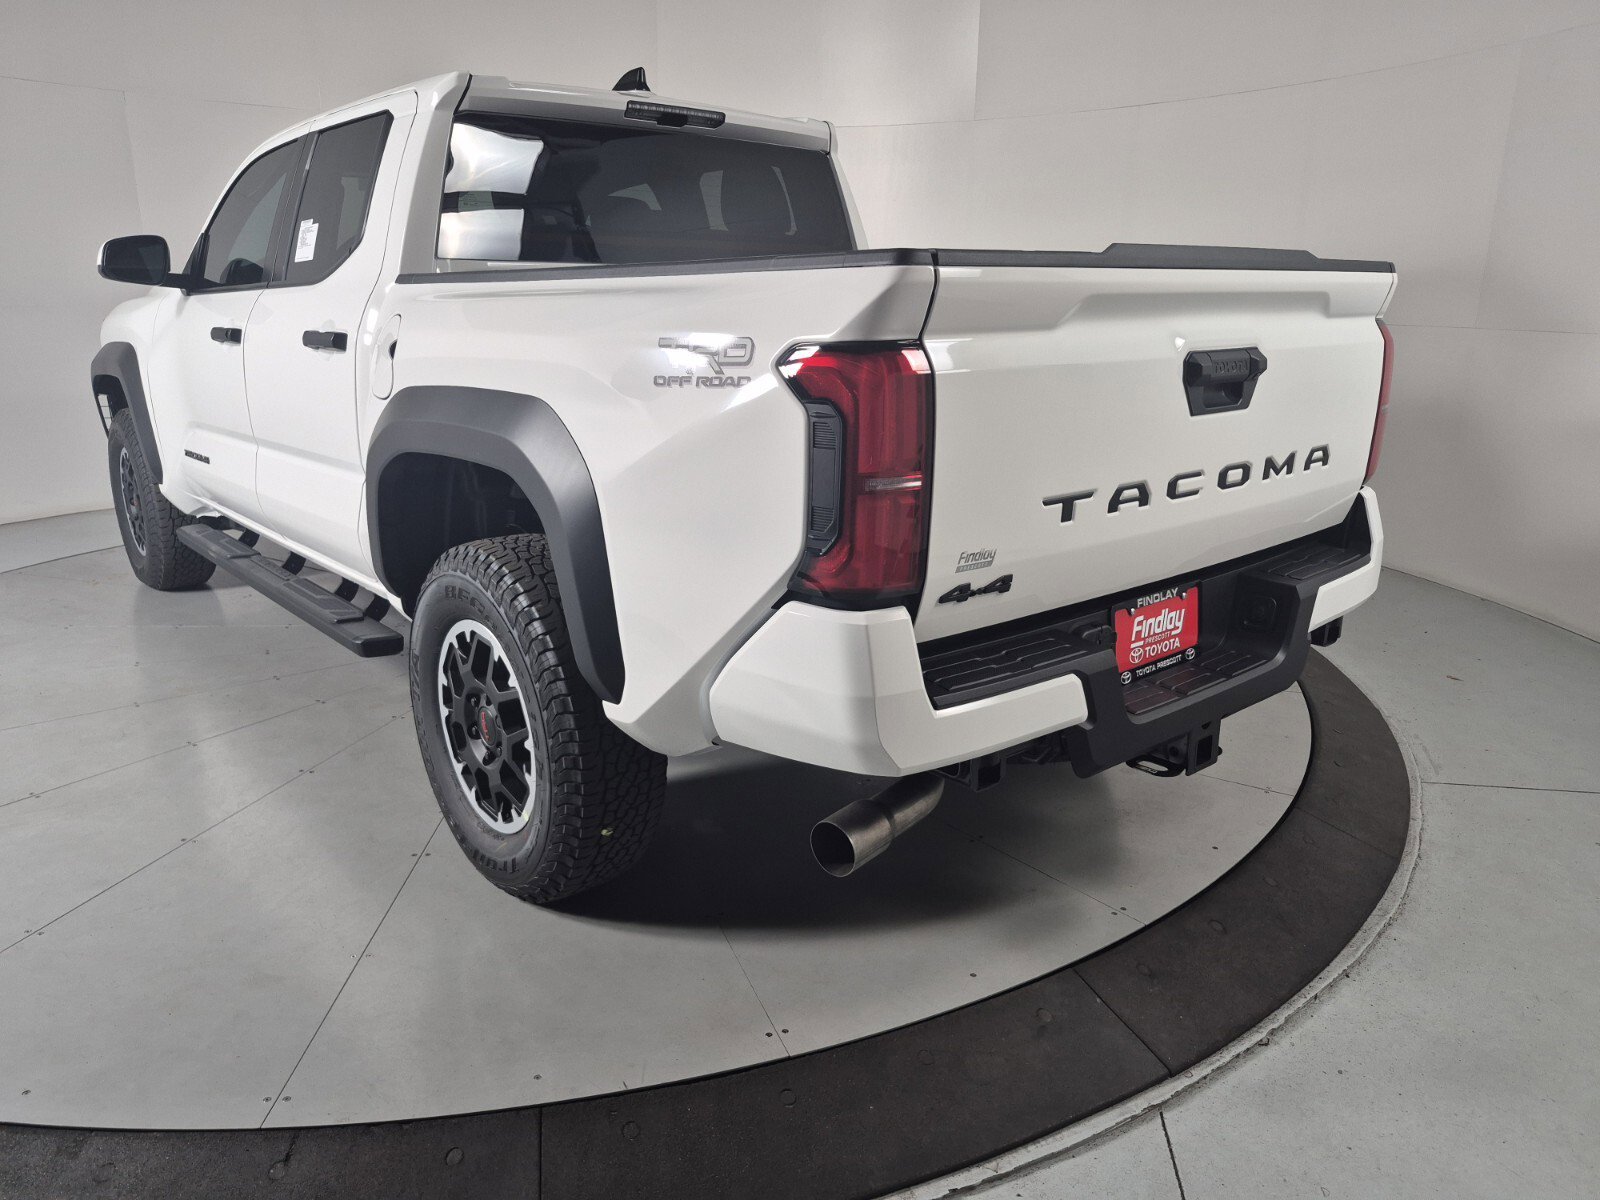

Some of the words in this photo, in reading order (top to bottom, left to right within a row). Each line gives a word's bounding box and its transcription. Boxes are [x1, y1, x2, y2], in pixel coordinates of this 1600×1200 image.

[653, 376, 692, 388] OFF
[695, 376, 752, 389] ROAD
[1042, 443, 1330, 523] TACOMA
[957, 548, 997, 565] Findlay
[1137, 587, 1179, 608] FINDLAY
[1131, 608, 1186, 642] Findlay
[1144, 637, 1181, 658] TOYOTA
[1145, 631, 1171, 644] PRESCOTT
[1135, 664, 1157, 677] TOYOTA
[1156, 654, 1182, 669] PRESCOTT
